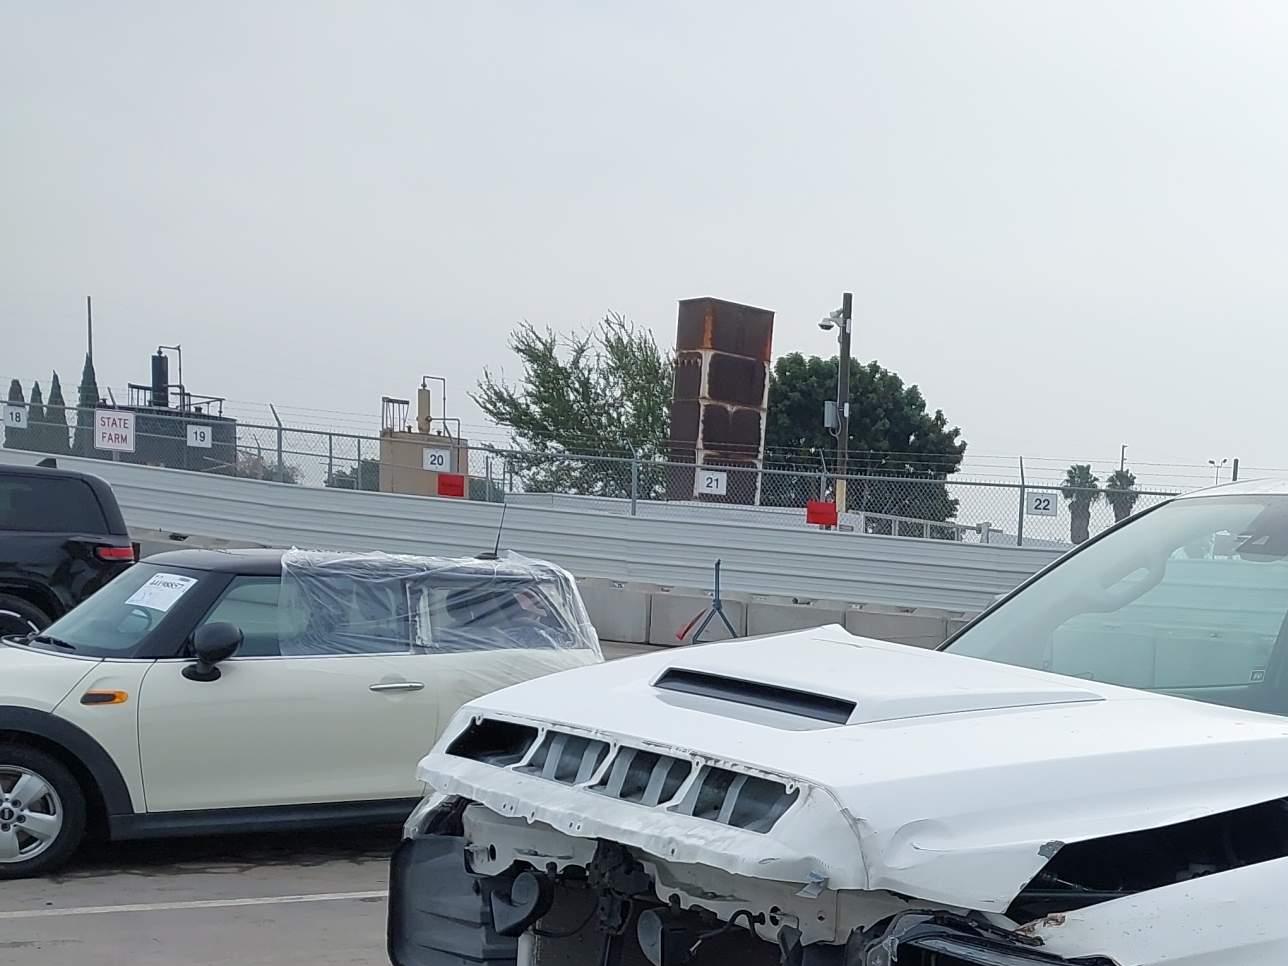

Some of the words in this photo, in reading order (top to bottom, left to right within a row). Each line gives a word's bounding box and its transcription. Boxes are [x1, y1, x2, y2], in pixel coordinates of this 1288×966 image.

[9, 411, 21, 423] 18
[100, 416, 129, 429] STATE
[101, 431, 128, 444] FARM
[192, 430, 206, 443] 19
[429, 454, 444, 466] 20
[705, 476, 719, 489] 21
[1033, 498, 1050, 511] 22
